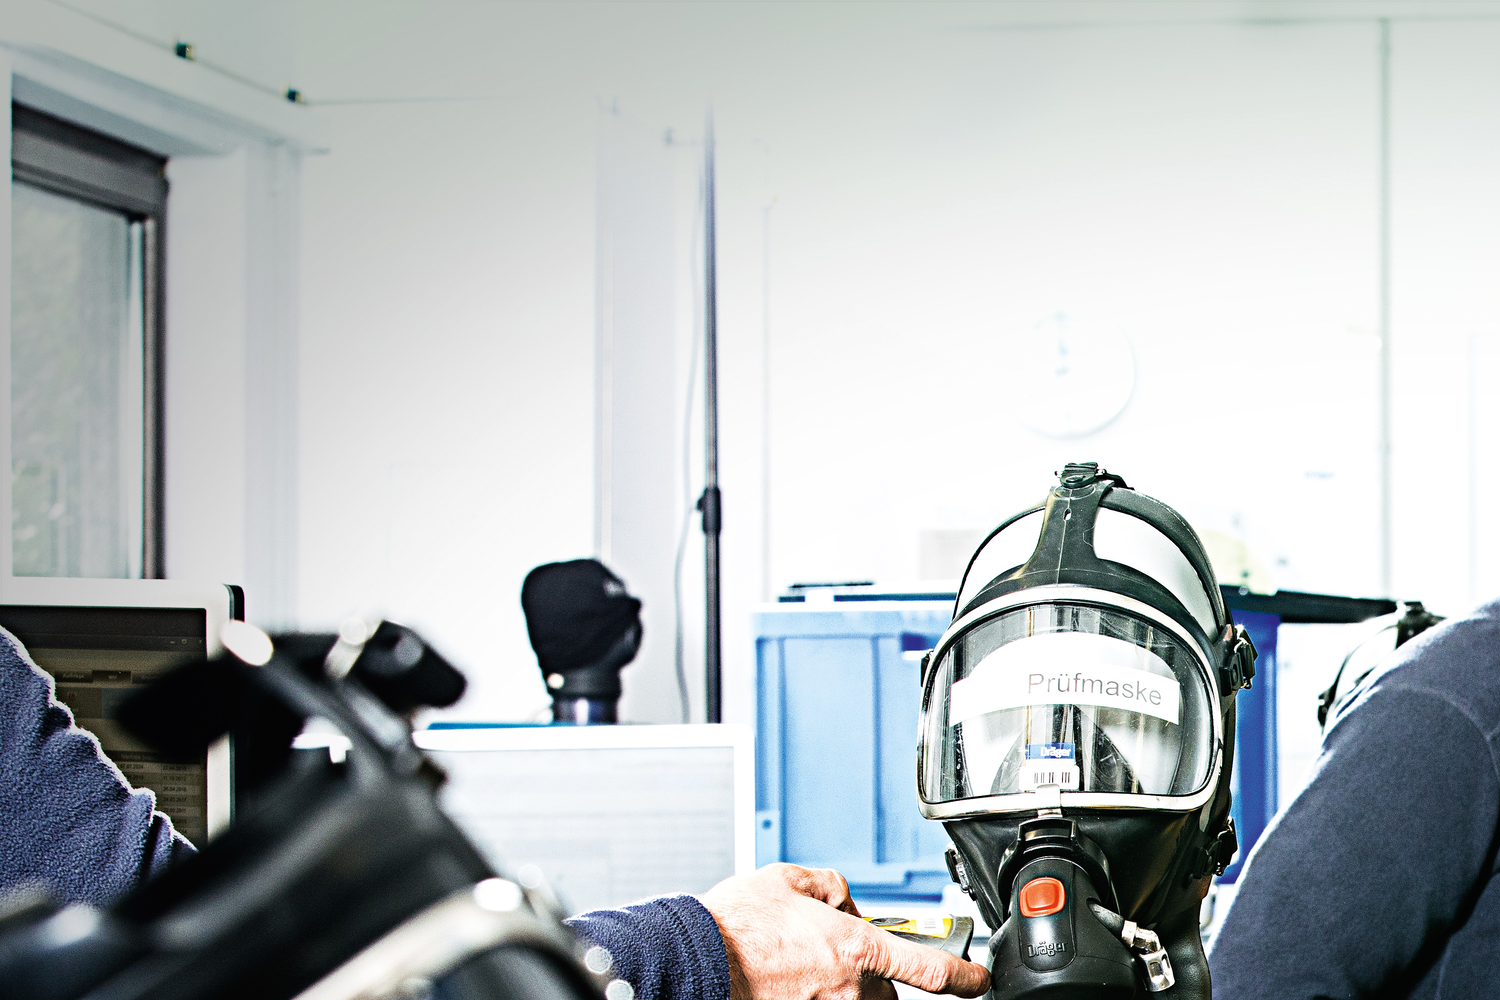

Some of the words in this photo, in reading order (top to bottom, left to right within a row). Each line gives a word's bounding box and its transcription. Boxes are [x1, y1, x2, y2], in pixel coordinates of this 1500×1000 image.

[1028, 672, 1162, 706] Prüfmaske
[1040, 746, 1072, 759] Dräger
[1028, 941, 1068, 958] Dräger
